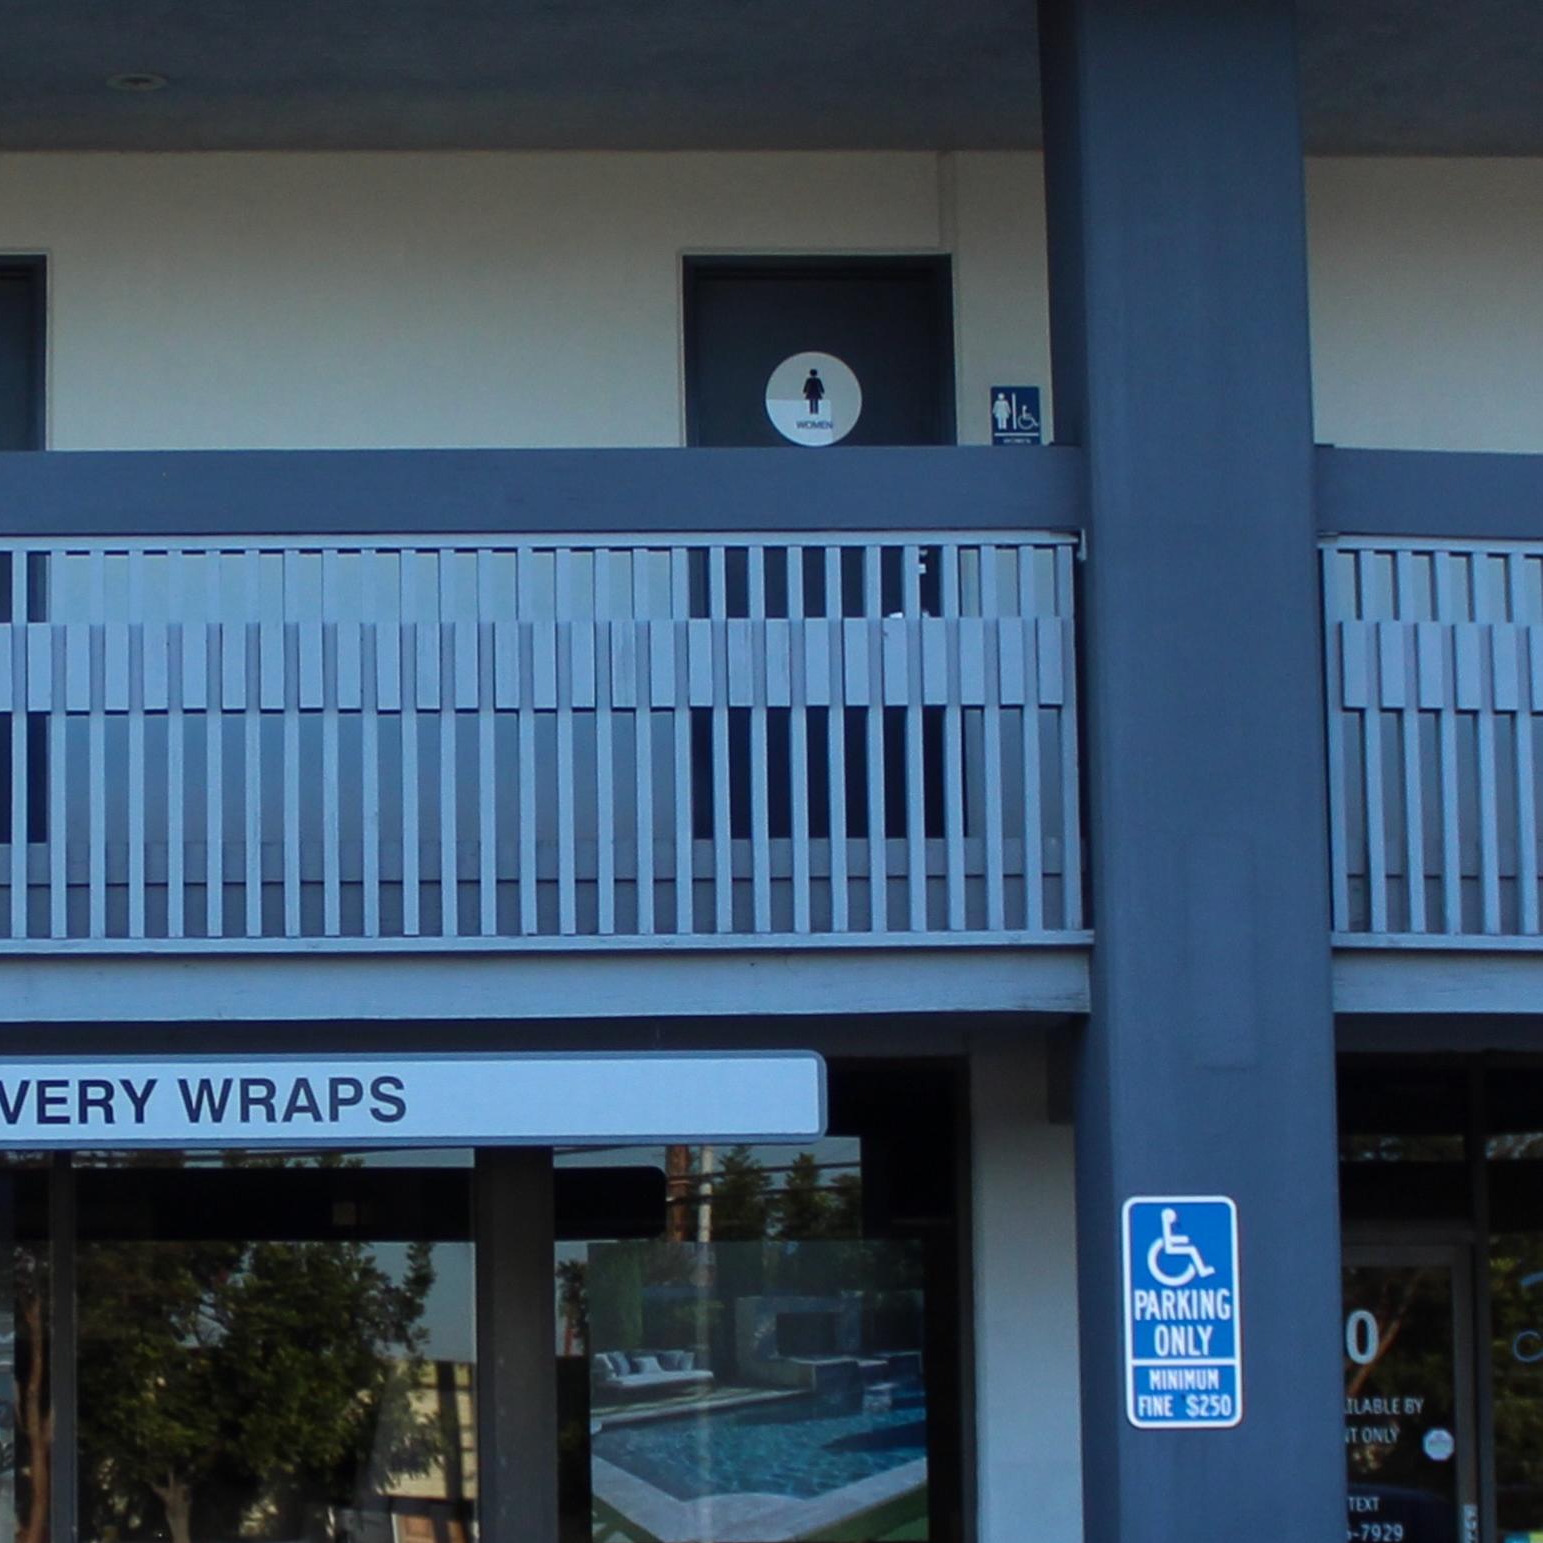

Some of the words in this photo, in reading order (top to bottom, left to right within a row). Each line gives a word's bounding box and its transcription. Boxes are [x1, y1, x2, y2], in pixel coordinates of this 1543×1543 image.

[796, 420, 833, 430] WOMEN
[179, 1076, 407, 1124] WRAPS
[1134, 1288, 1231, 1321] PARKING
[1153, 1324, 1213, 1357] ONLY
[1149, 1369, 1219, 1391] MINIMUM
[1138, 1395, 1174, 1418] FINE
[1186, 1394, 1232, 1418] $250
[1346, 1398, 1401, 1415] ILABLE
[1404, 1398, 1424, 1415] BY
[1362, 1427, 1401, 1444] ONLY
[1348, 1496, 1380, 1513] TEXT
